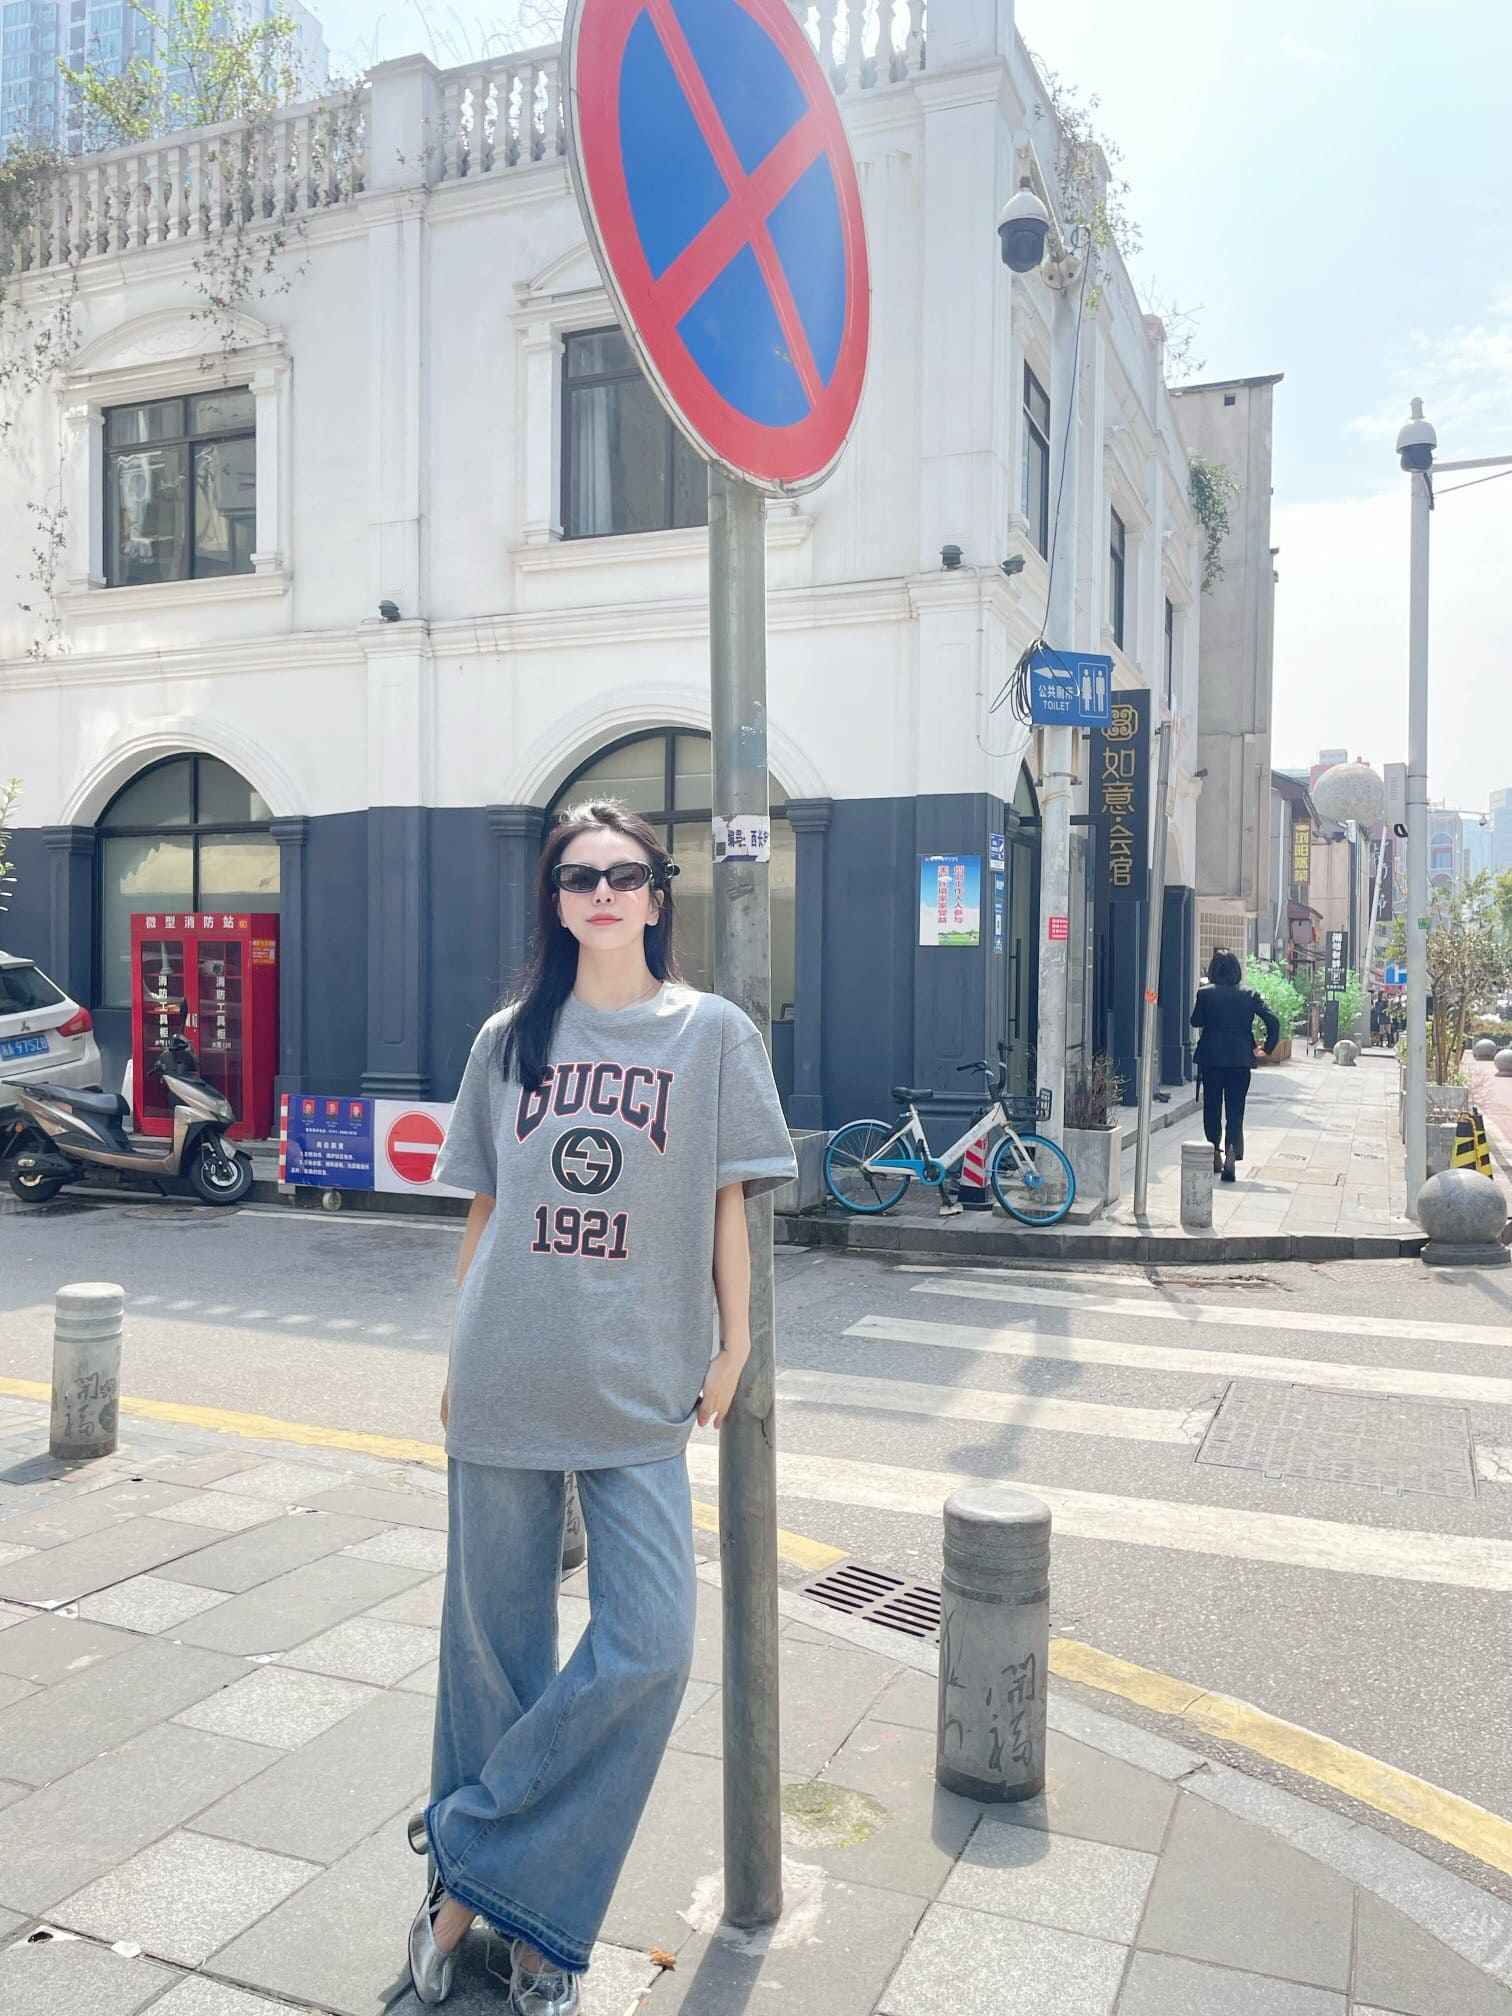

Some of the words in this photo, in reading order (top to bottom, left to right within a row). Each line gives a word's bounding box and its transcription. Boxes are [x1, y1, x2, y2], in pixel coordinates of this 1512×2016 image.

[1038, 684, 1073, 700] 公共厕所
[1043, 700, 1070, 711] TOILET
[145, 915, 234, 929] 微型消防站
[515, 1061, 675, 1155] GUCCI
[531, 1203, 629, 1261] 1921
